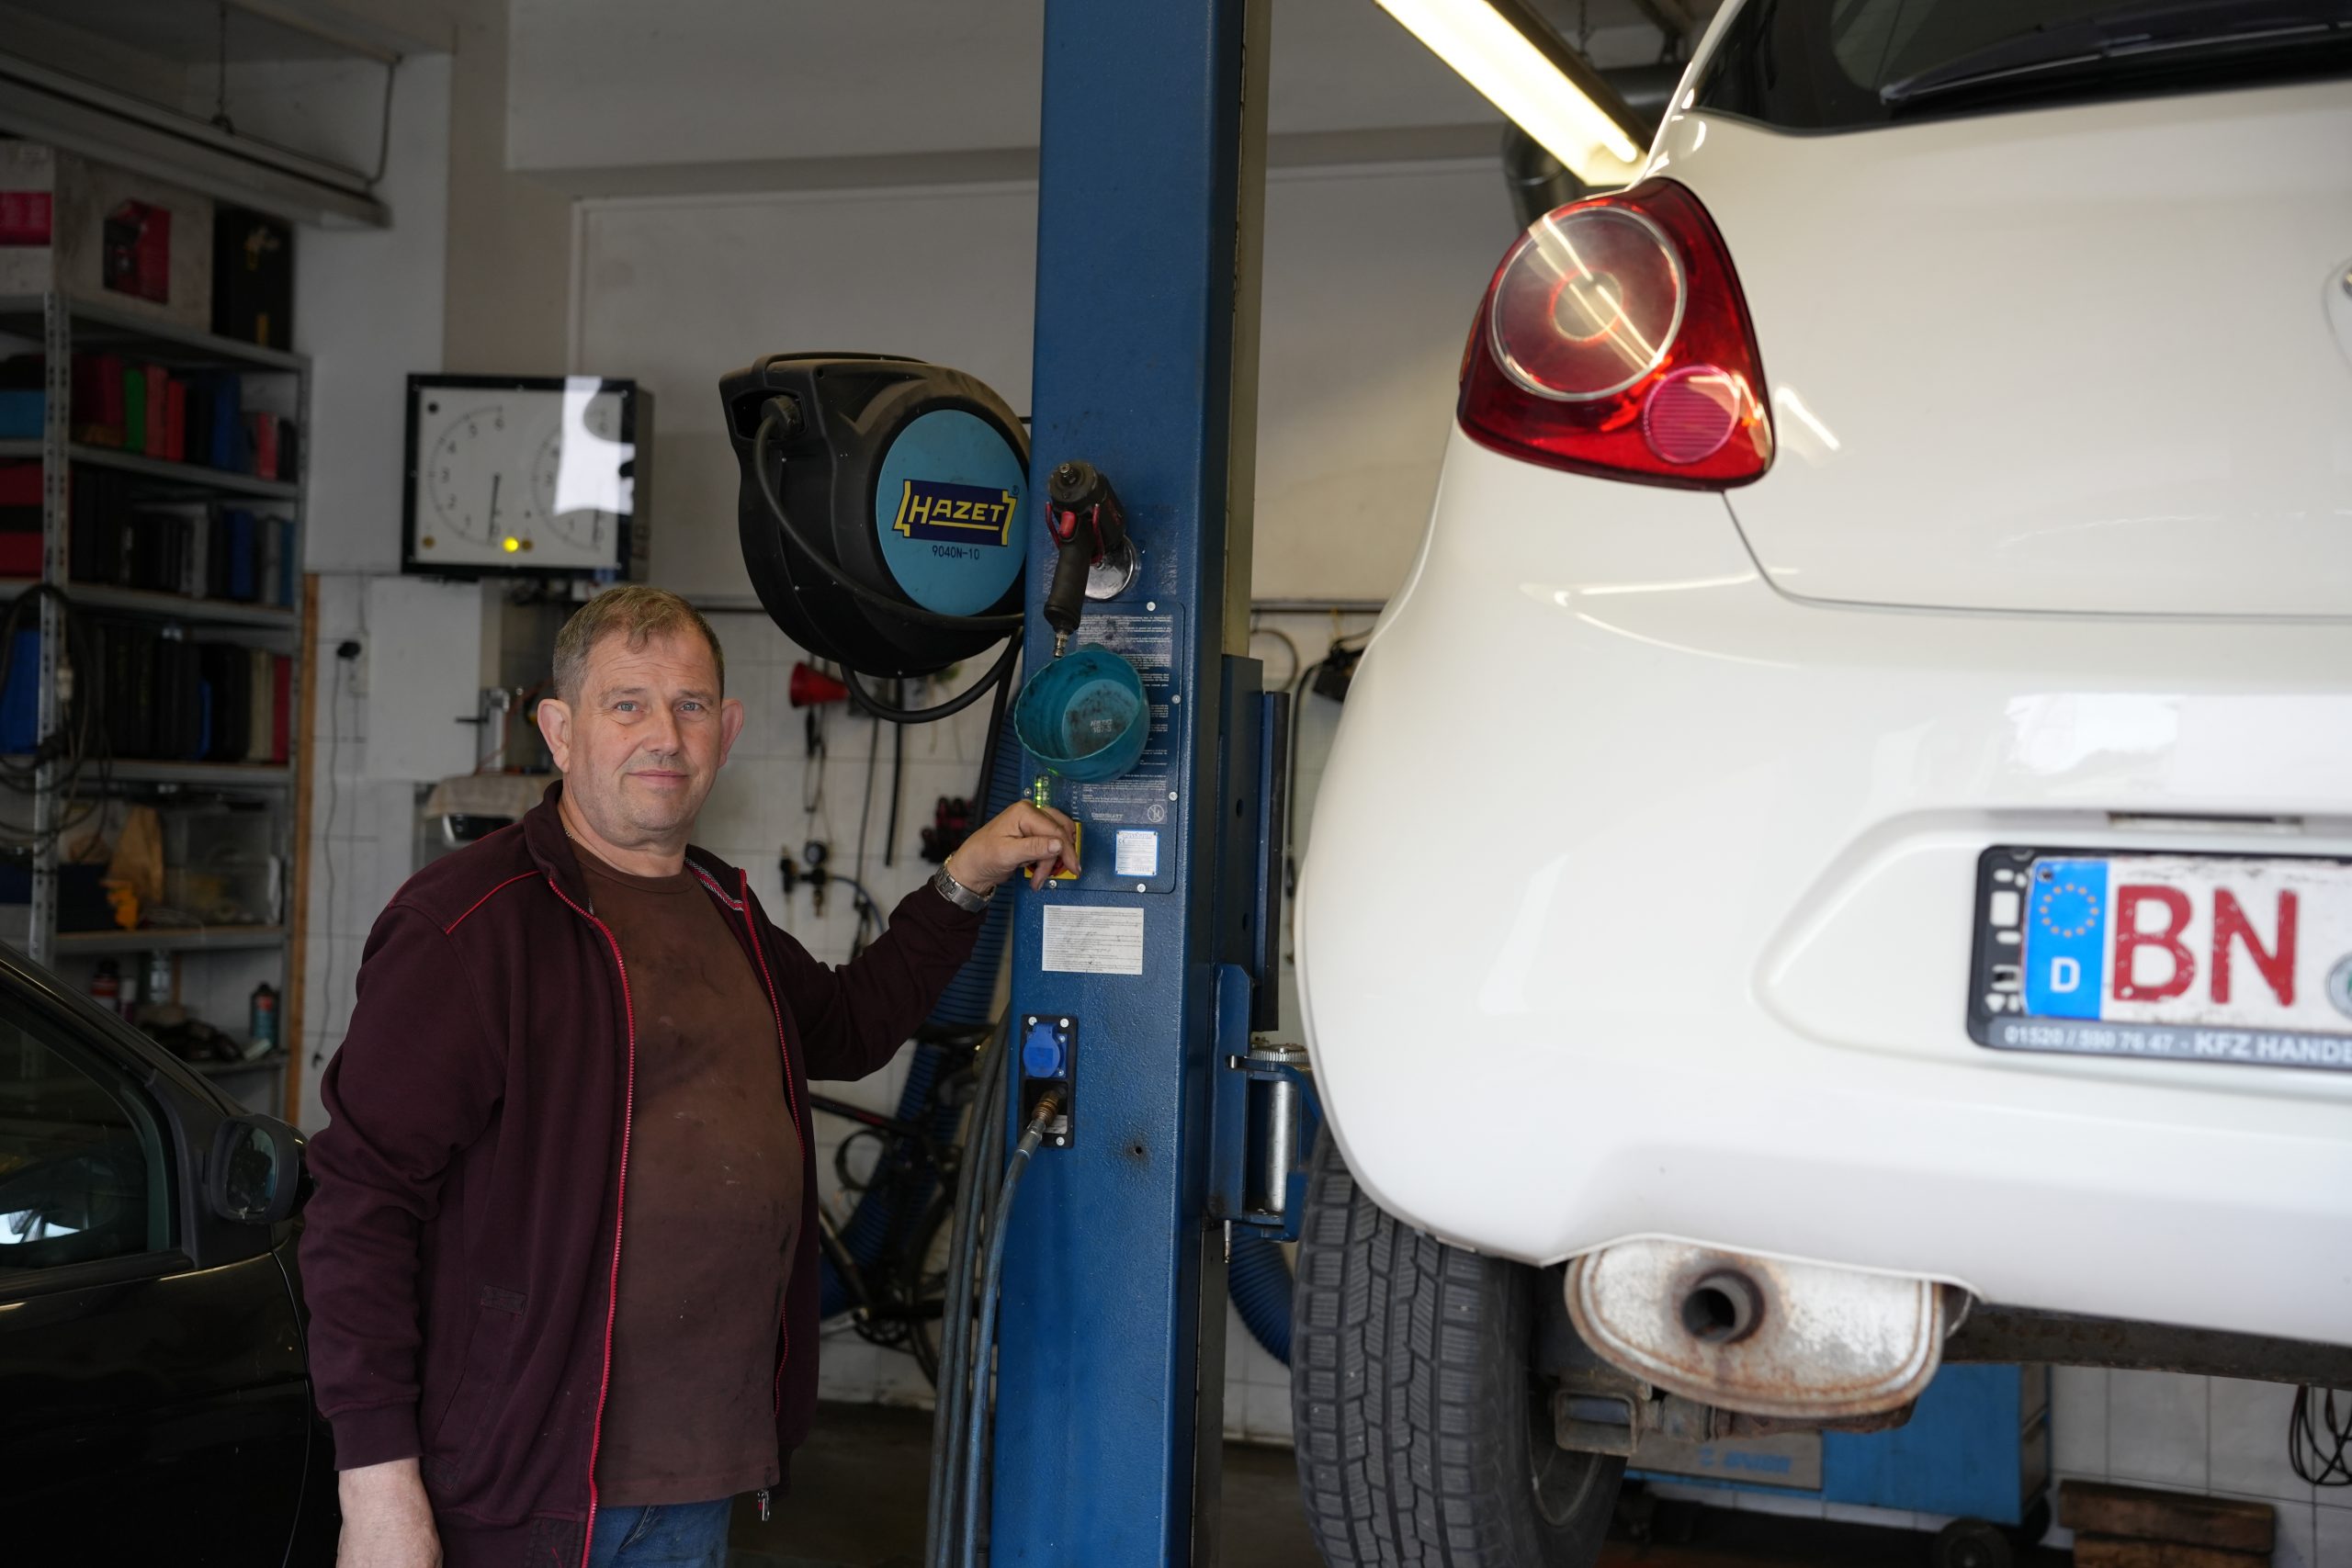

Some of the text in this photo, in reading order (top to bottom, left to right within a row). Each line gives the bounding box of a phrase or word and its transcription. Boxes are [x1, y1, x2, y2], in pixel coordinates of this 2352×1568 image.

[908, 495, 1005, 525] HAZET
[932, 545, 980, 560] 9040N-10
[2112, 884, 2299, 1008] BN
[2049, 956, 2080, 993] D
[2148, 1033, 2175, 1053] 47
[2193, 1032, 2252, 1058] KFZ
